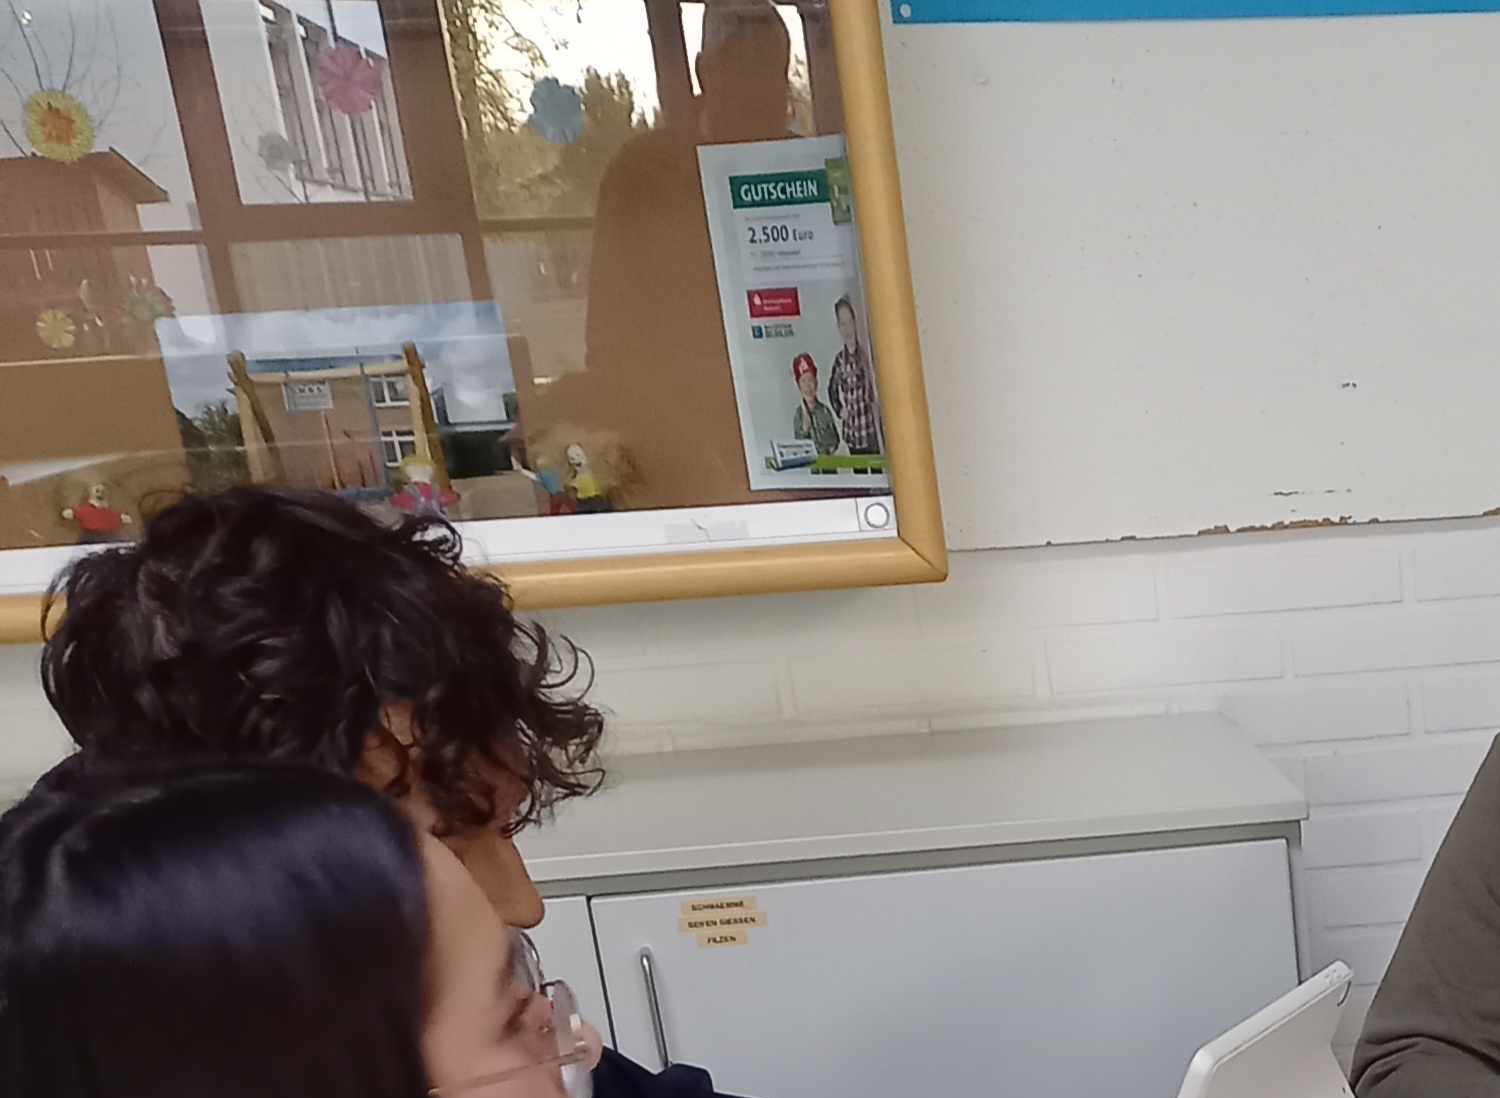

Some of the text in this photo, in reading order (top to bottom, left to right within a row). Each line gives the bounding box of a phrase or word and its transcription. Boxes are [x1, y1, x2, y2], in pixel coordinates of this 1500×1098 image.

[740, 179, 818, 201] GUTSCHEIN
[748, 224, 814, 244] 2.500 Euro
[707, 935, 736, 944] FILZEN
